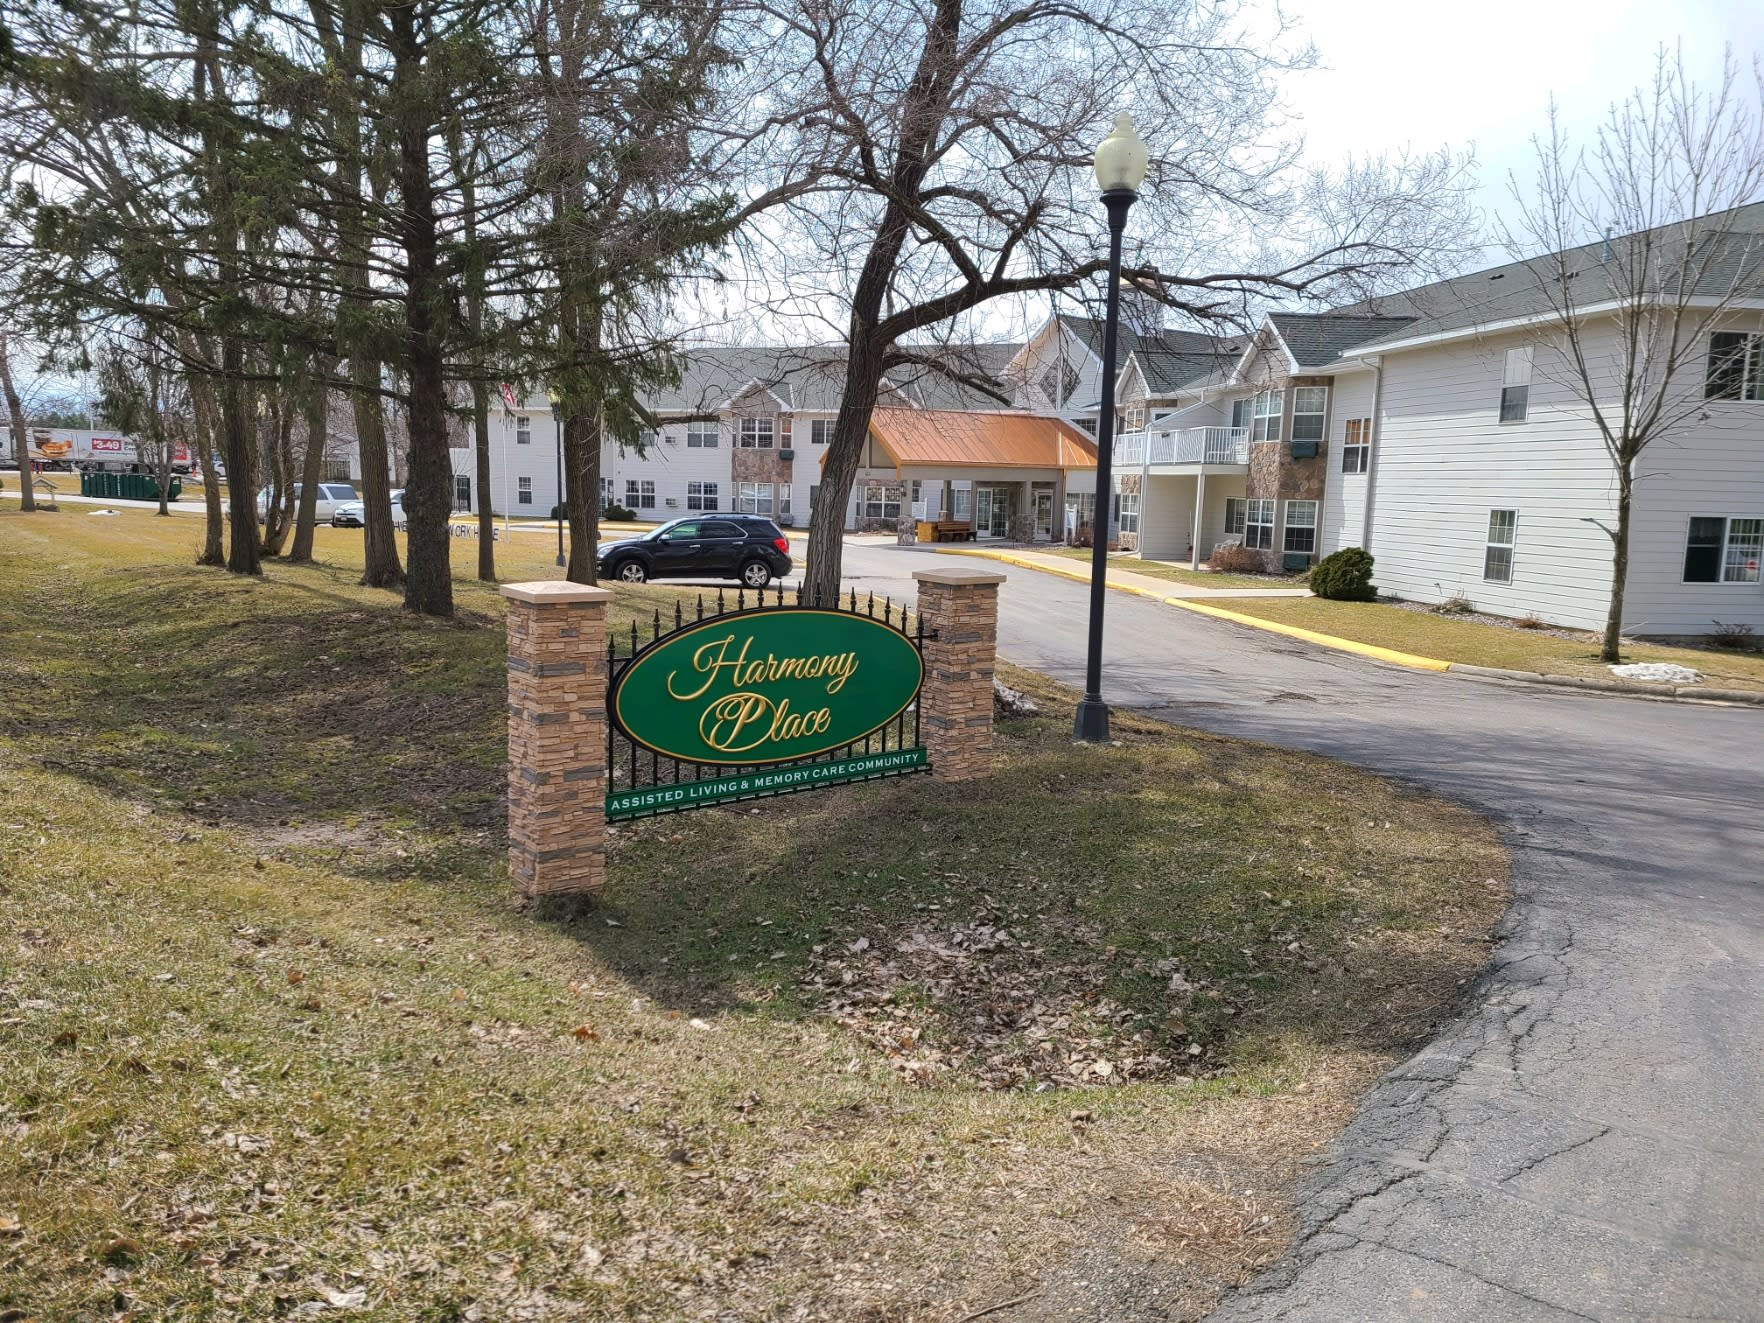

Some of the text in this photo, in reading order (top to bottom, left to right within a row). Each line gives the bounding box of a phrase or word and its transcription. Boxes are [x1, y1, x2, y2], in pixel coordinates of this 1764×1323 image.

[473, 526, 499, 541] HE
[667, 634, 859, 701] Harmony
[699, 692, 832, 752] Place
[611, 753, 919, 811] ASSISTED LIVING & MEMORY CARE COMMUNITY
